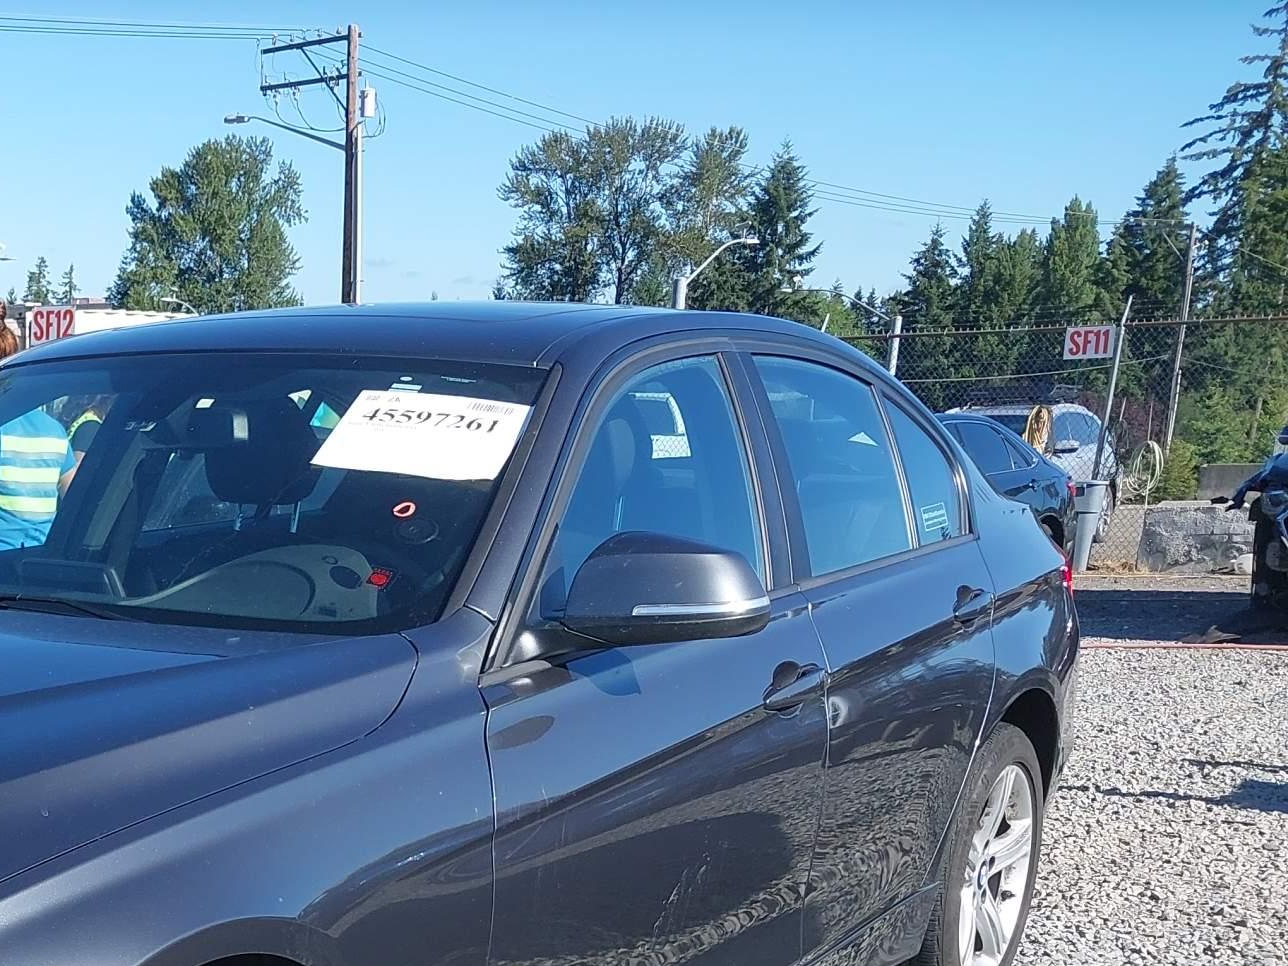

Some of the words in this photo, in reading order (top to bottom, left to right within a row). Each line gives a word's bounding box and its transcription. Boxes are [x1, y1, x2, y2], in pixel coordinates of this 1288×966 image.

[33, 309, 74, 342] SF12
[1068, 329, 1110, 356] SF11
[362, 407, 499, 433] 45597261
